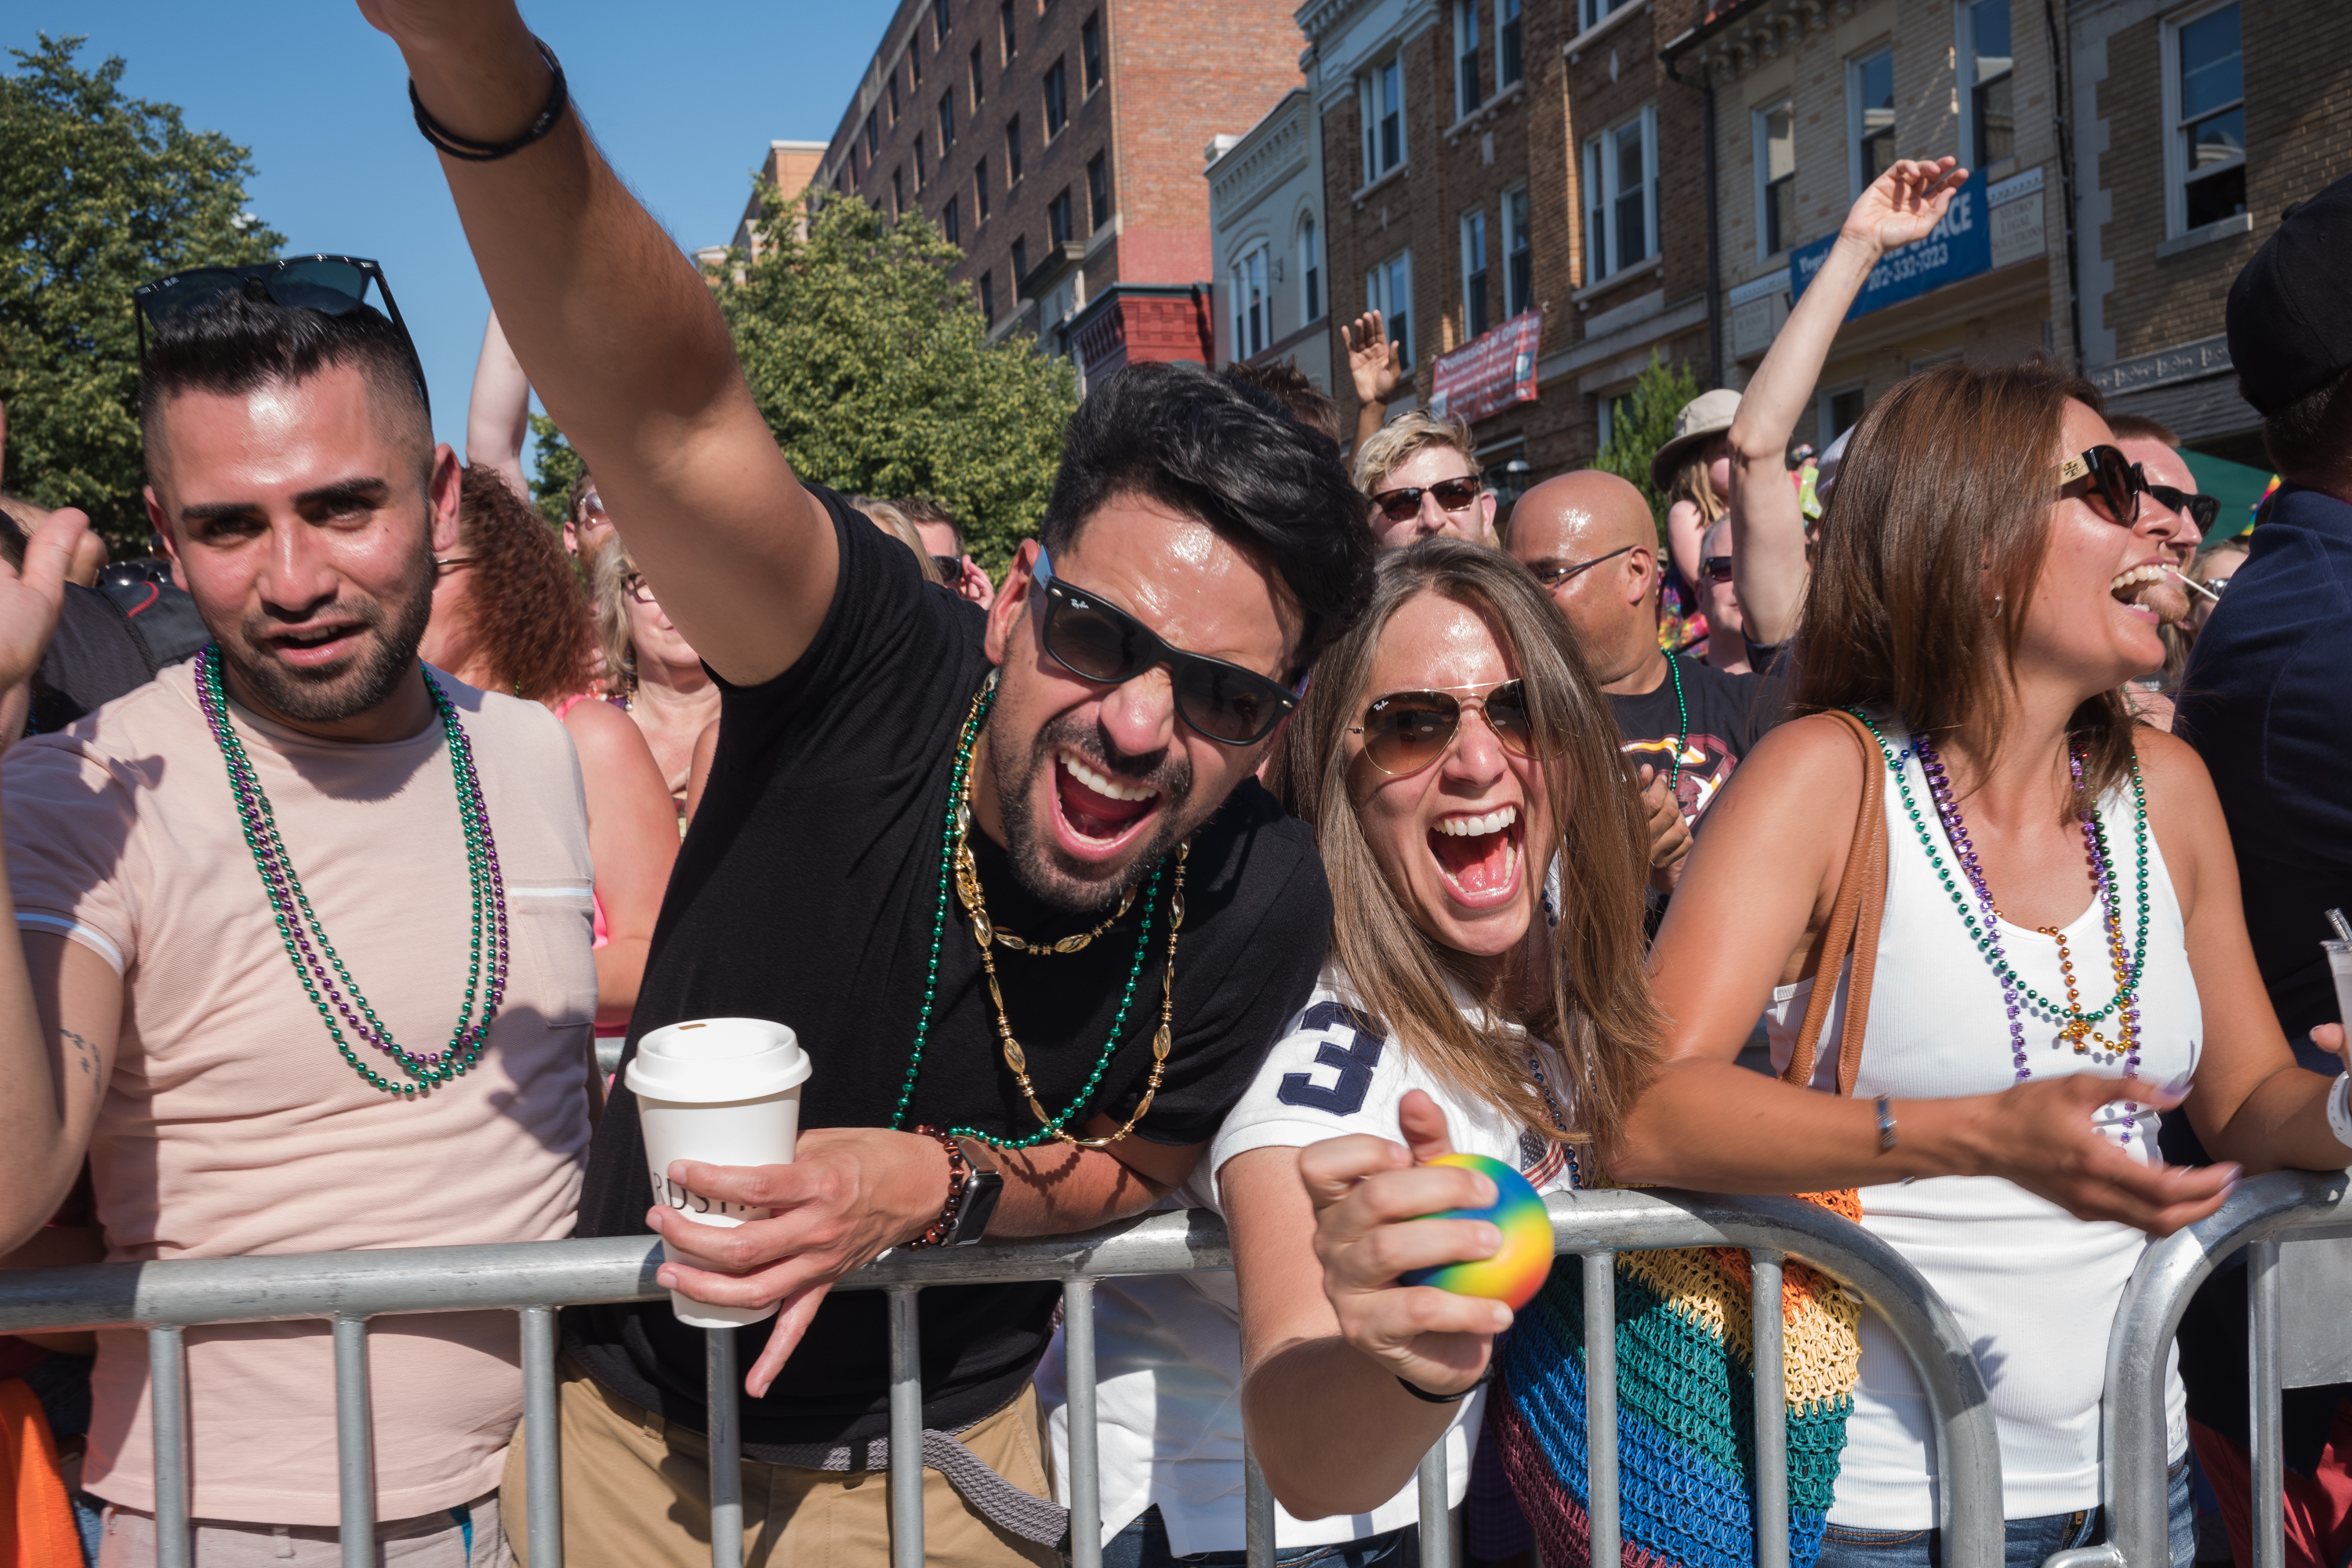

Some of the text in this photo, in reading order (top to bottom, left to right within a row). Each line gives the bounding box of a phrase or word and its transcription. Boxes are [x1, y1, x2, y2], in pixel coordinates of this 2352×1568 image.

[1438, 333, 1501, 373] Professional
[1501, 315, 1540, 343] Offices
[1276, 1000, 1388, 1116] 3
